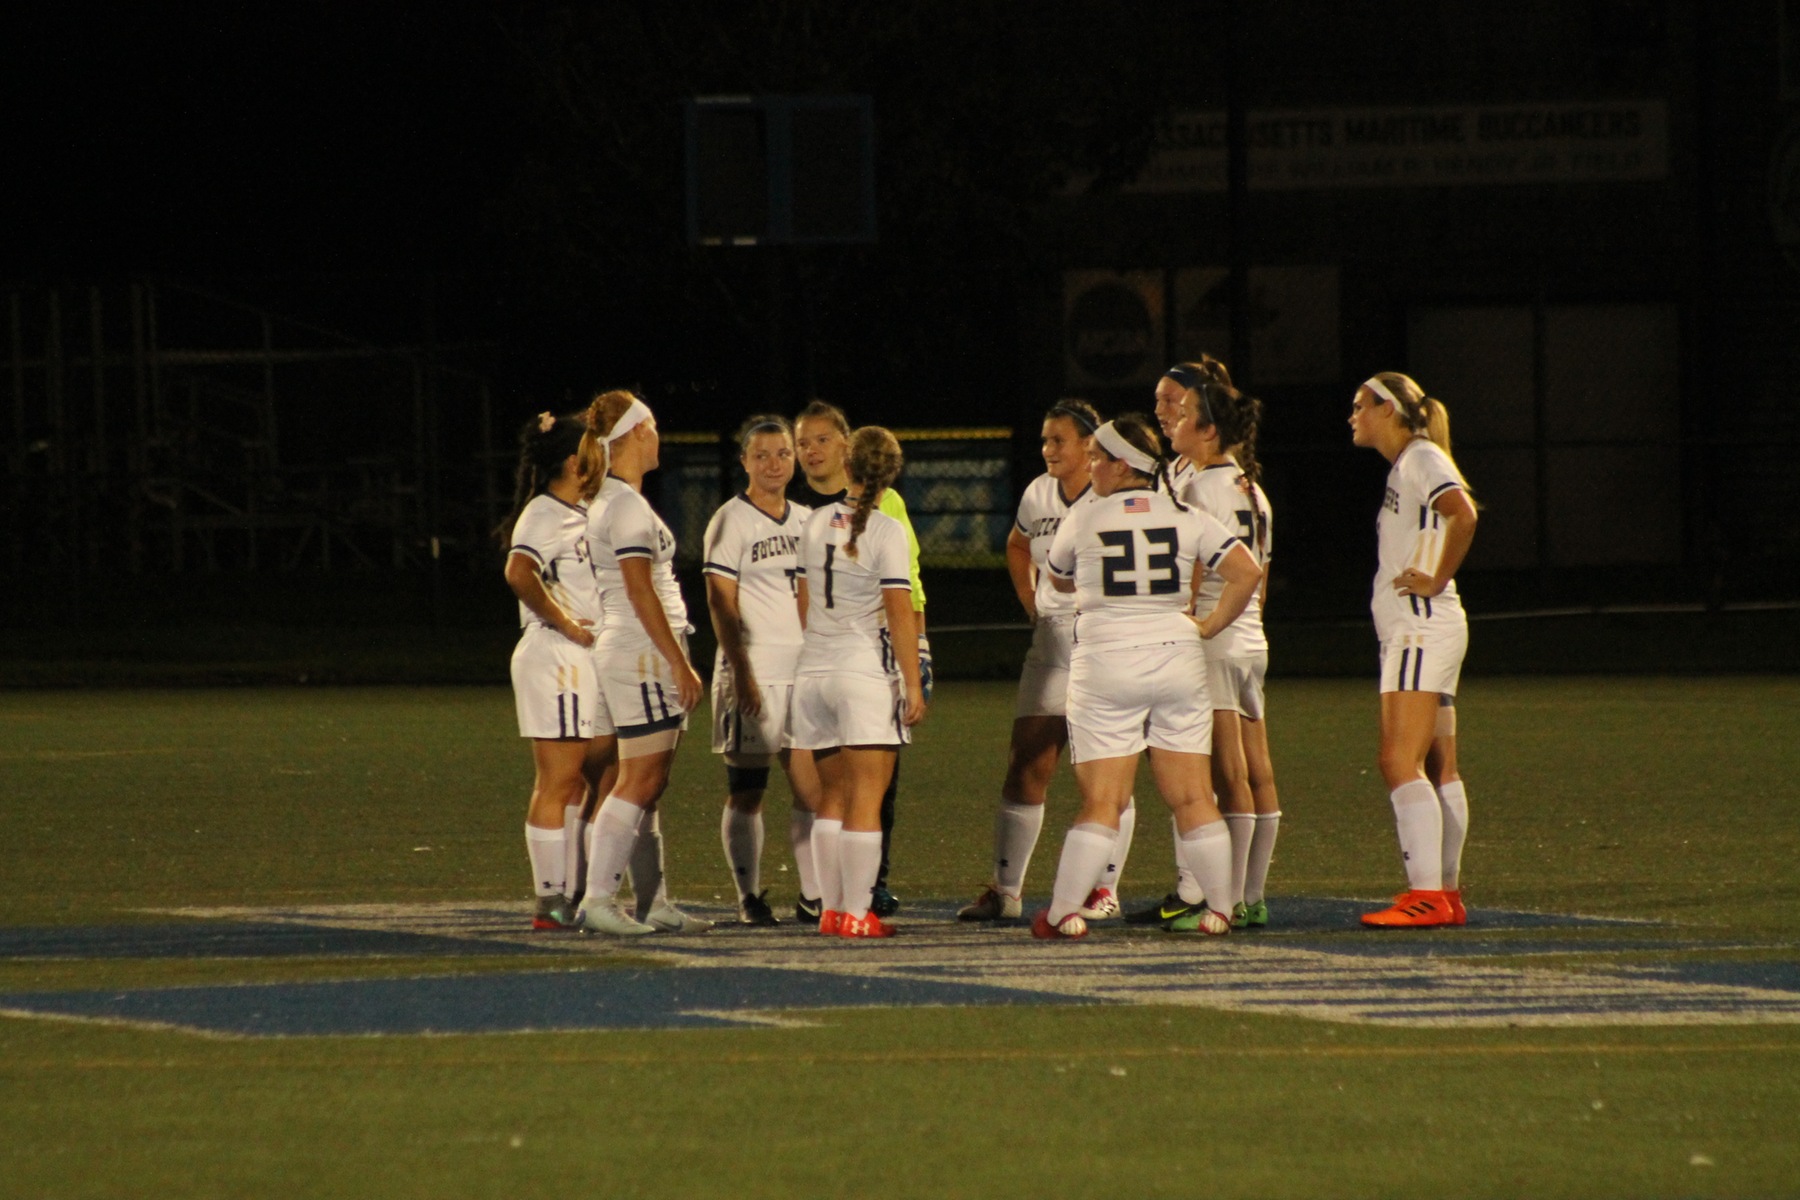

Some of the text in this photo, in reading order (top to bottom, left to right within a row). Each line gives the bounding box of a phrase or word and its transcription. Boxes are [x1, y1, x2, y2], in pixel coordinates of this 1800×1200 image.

[1477, 109, 1641, 141] BUCCANEERS
[824, 543, 837, 609] 1
[1096, 527, 1183, 597] 23
